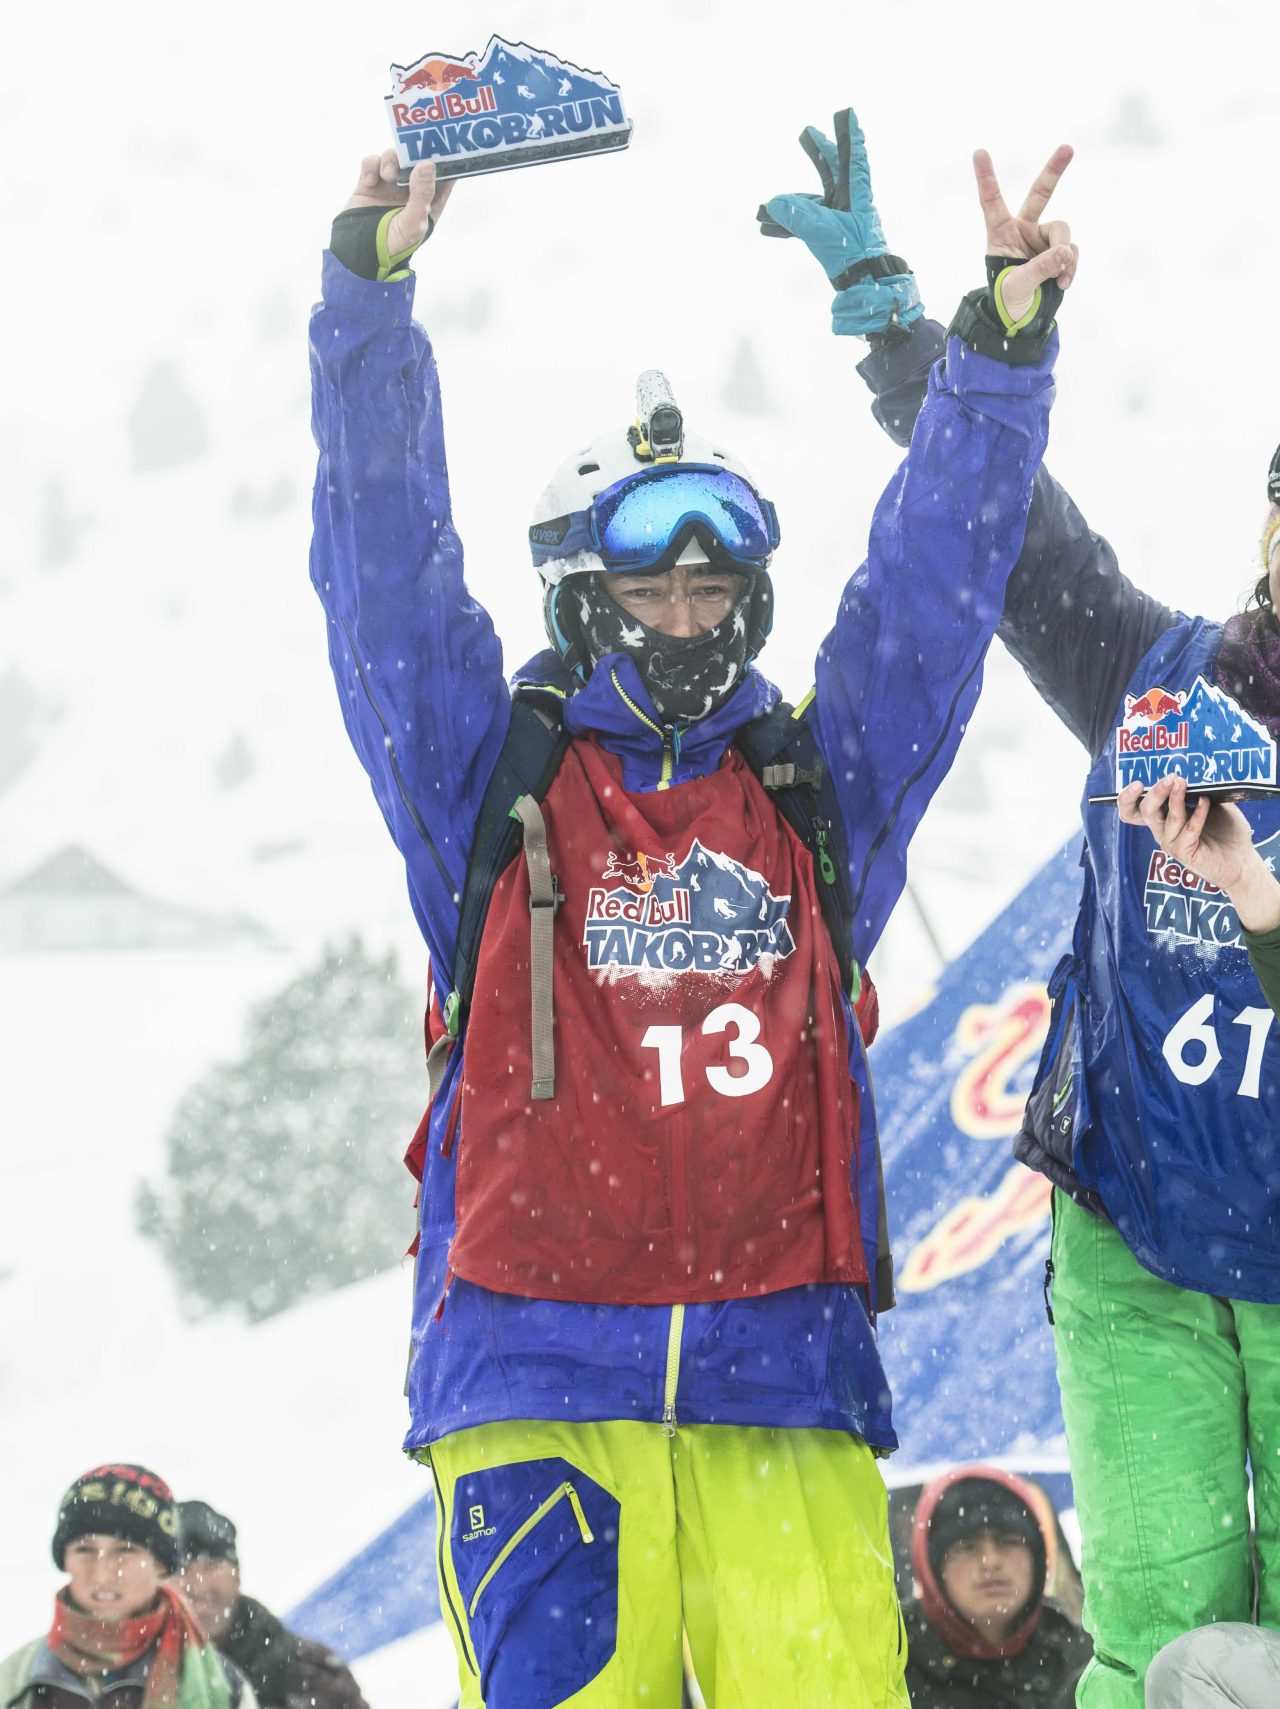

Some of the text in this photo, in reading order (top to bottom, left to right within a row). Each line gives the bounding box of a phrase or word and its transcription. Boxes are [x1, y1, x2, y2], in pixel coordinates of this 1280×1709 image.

[392, 86, 497, 127] Red Bull
[398, 93, 625, 161] TAKOB RUN
[532, 527, 560, 543] uvex
[1118, 722, 1190, 754] Red Bull
[1216, 747, 1272, 784] RUN
[588, 888, 645, 923] Red
[1146, 892, 1248, 949] TAKO
[585, 926, 722, 970] TAKOB
[640, 1002, 774, 1107] 13
[1161, 992, 1275, 1099] 61
